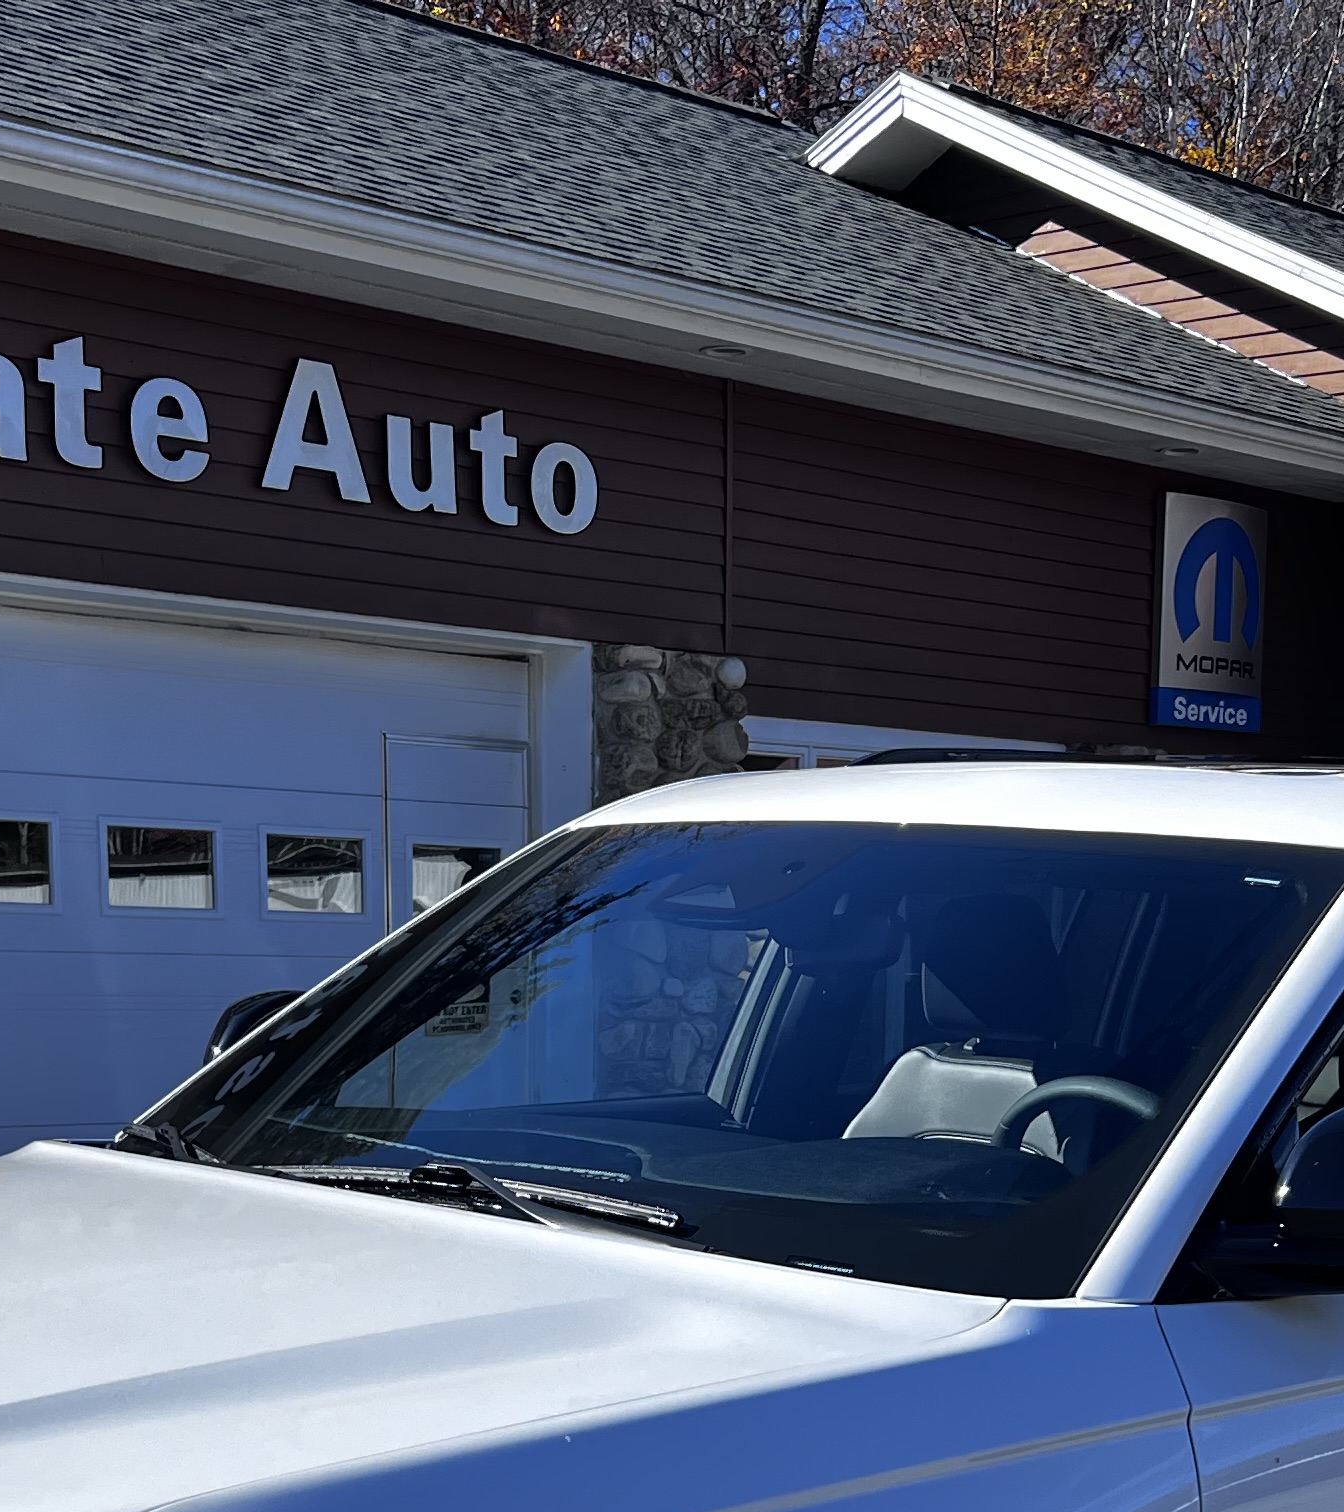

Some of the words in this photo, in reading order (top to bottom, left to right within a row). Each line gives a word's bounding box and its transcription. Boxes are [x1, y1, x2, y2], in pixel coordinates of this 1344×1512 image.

[261, 357, 598, 535] Auto
[1176, 653, 1254, 679] MOPAR
[1173, 696, 1247, 726] Service
